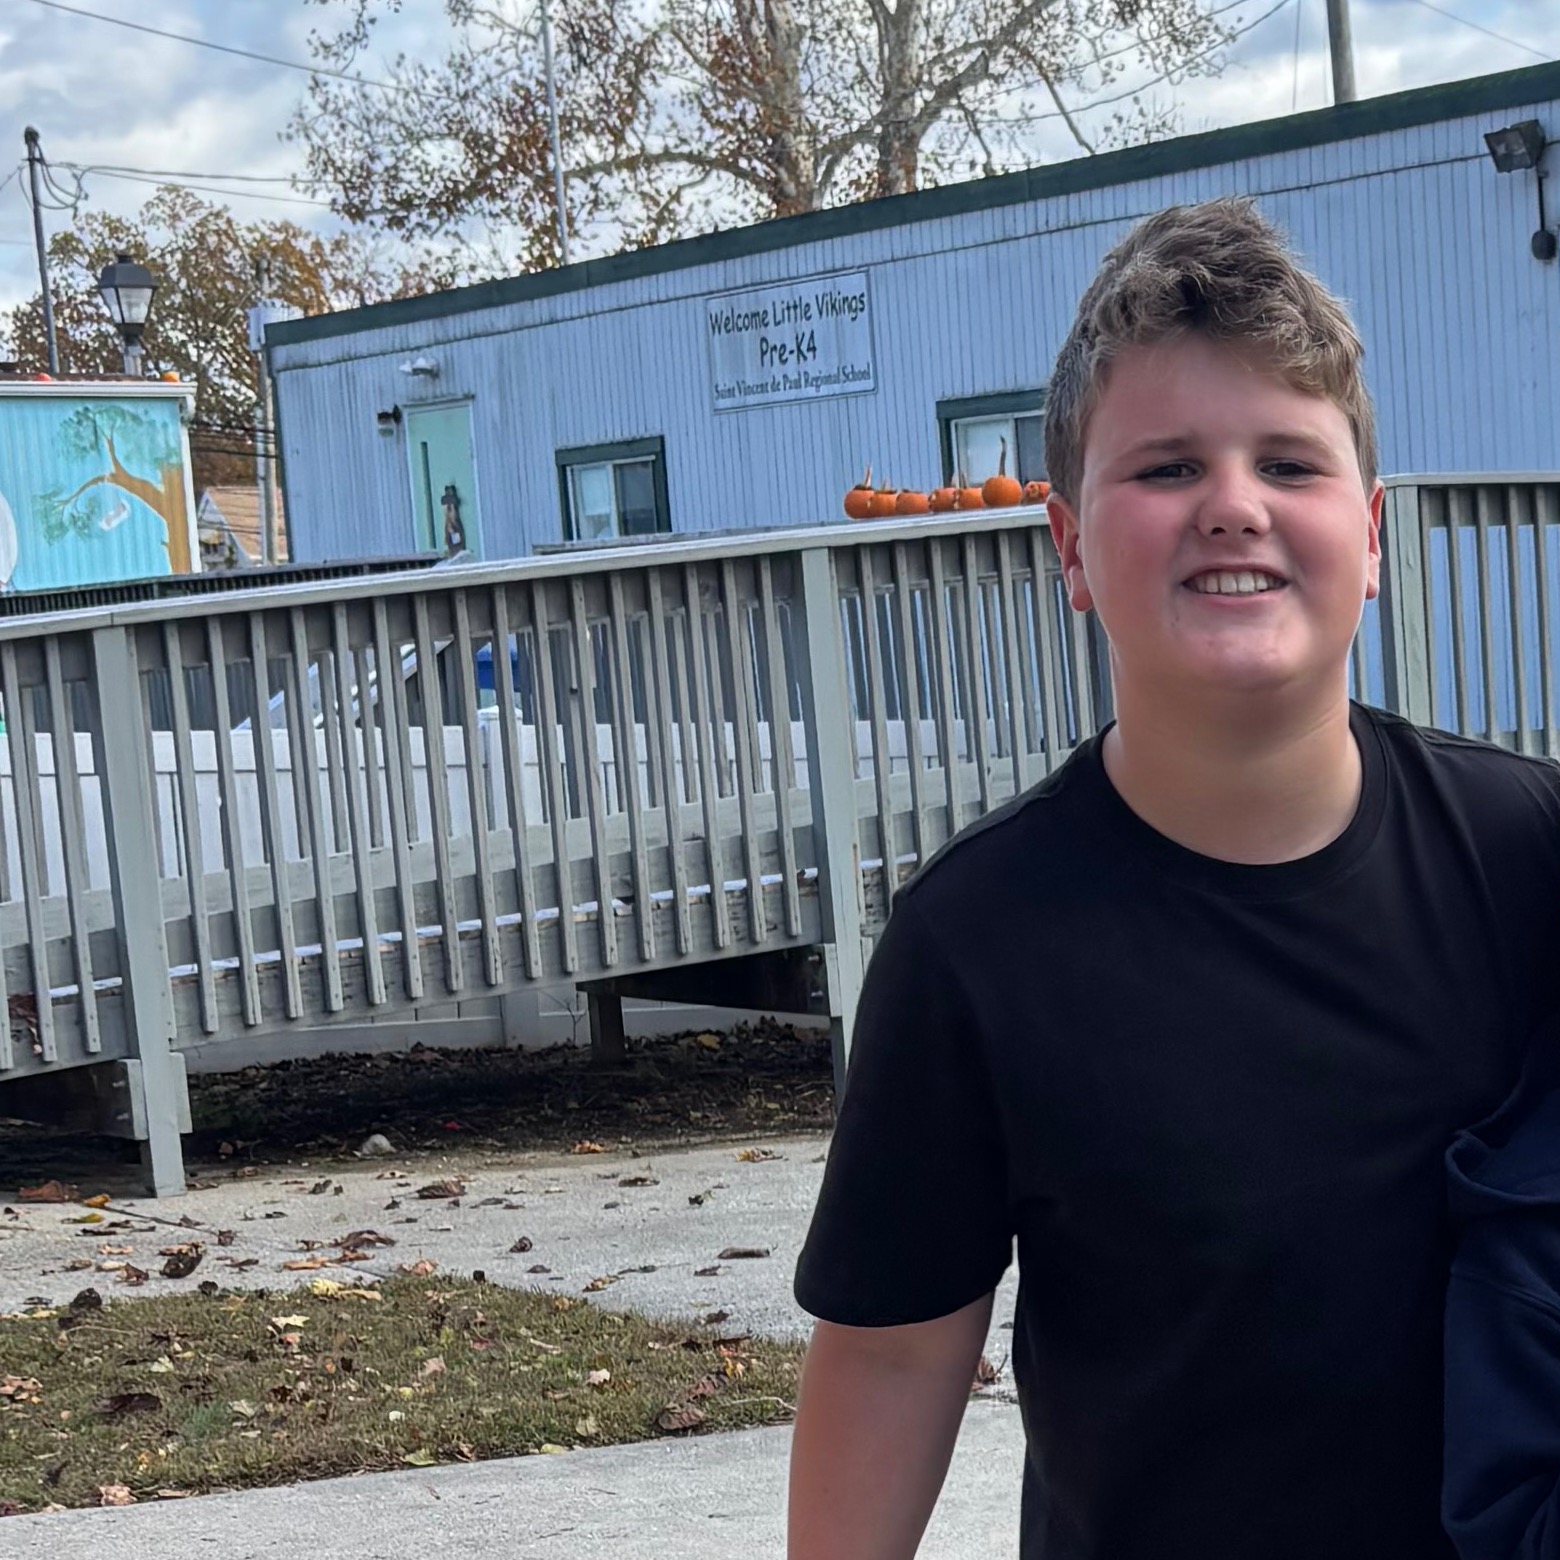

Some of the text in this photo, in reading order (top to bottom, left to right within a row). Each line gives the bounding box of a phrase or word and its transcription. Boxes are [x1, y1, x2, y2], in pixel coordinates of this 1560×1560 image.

[710, 291, 864, 335] Welcome Little Vikings
[759, 329, 816, 367] Pre-K4
[714, 361, 871, 399] Saint Vincent de Paul Regional School
